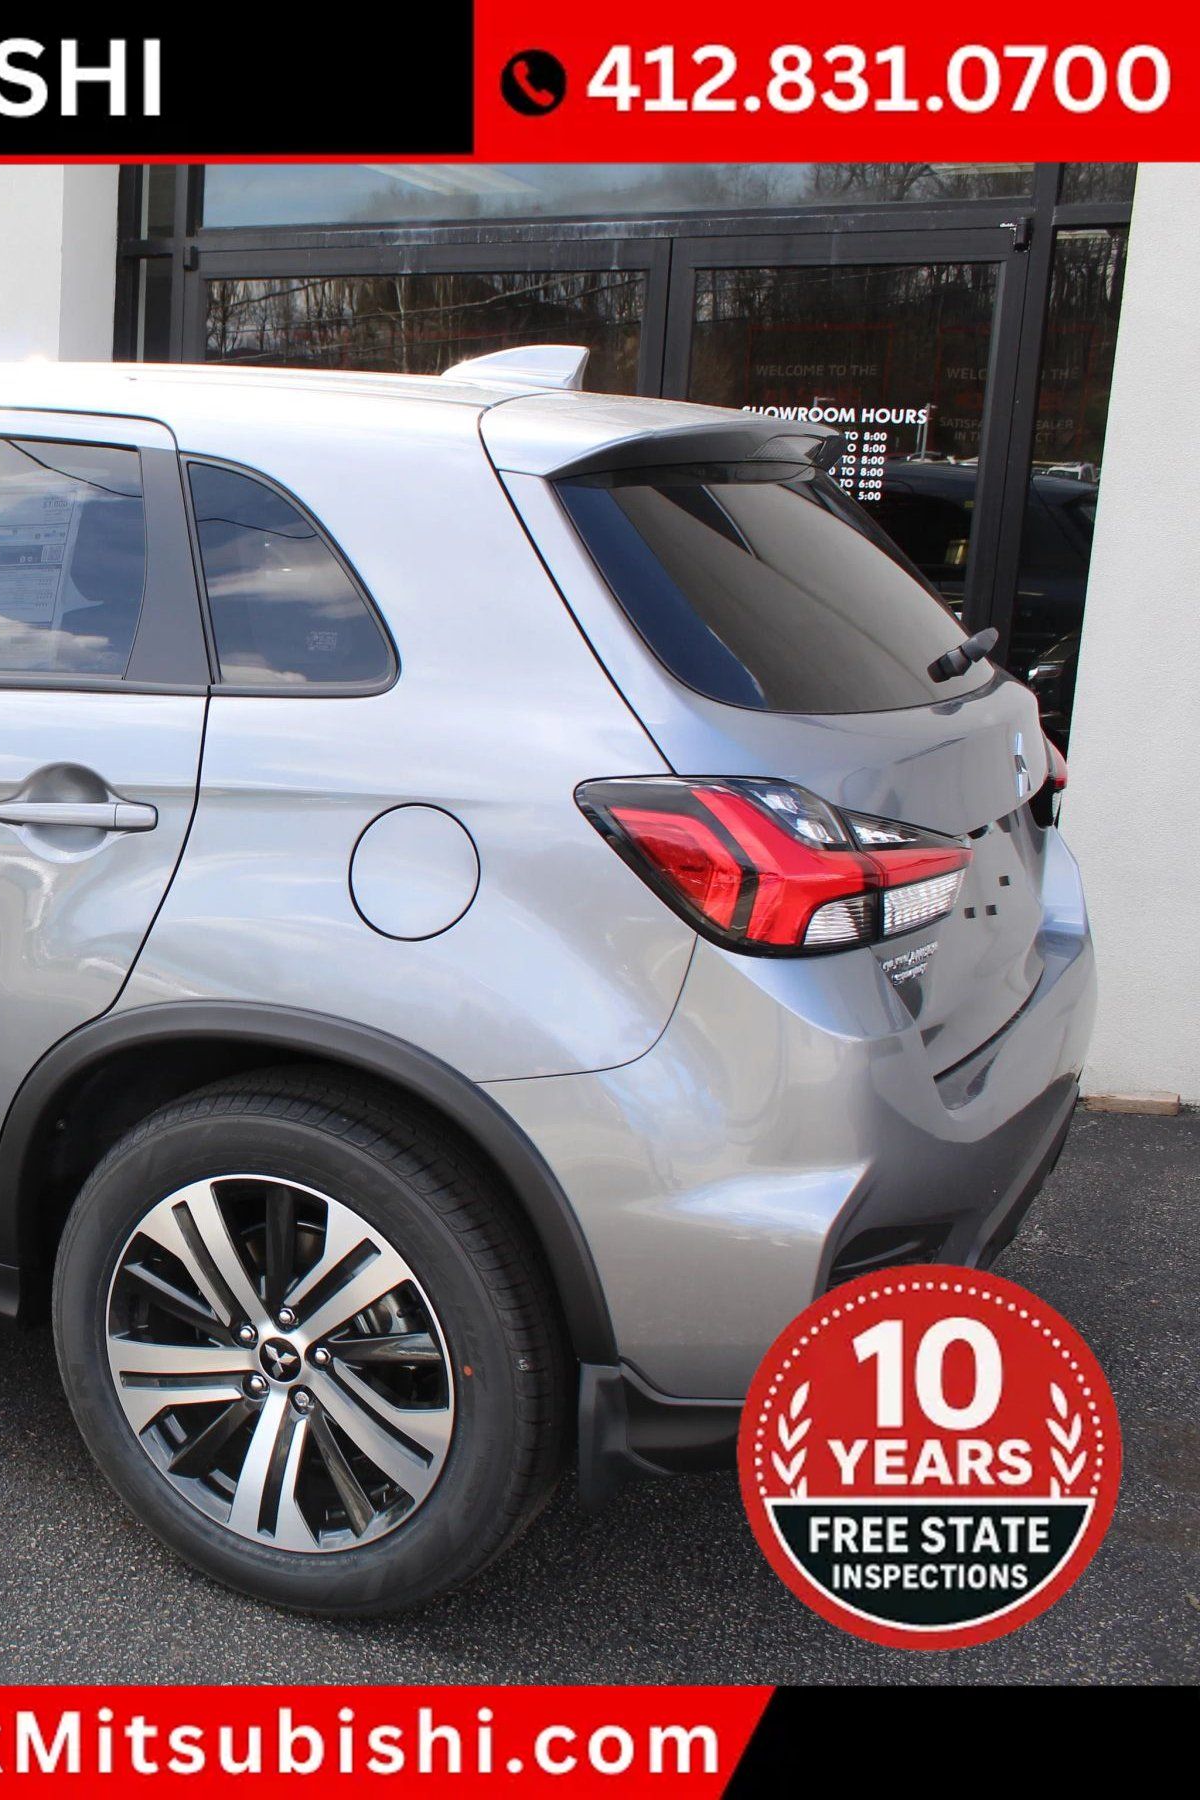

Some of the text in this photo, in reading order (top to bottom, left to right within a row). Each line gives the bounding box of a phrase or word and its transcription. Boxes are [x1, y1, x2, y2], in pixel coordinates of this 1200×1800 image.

[756, 365, 879, 377] WELCOME TO THE
[946, 367, 987, 380] WELC
[1050, 366, 1080, 380] THE
[861, 408, 927, 424] HOURS
[940, 417, 1074, 430] SATISFA EALER
[845, 431, 887, 441] TO 8:00
[847, 443, 886, 453] O 8:00
[842, 455, 885, 465] TO 8:00
[841, 467, 855, 476] TO
[860, 468, 883, 477] 8:00
[840, 478, 882, 489] TO 6:00
[858, 491, 881, 501] 5:00
